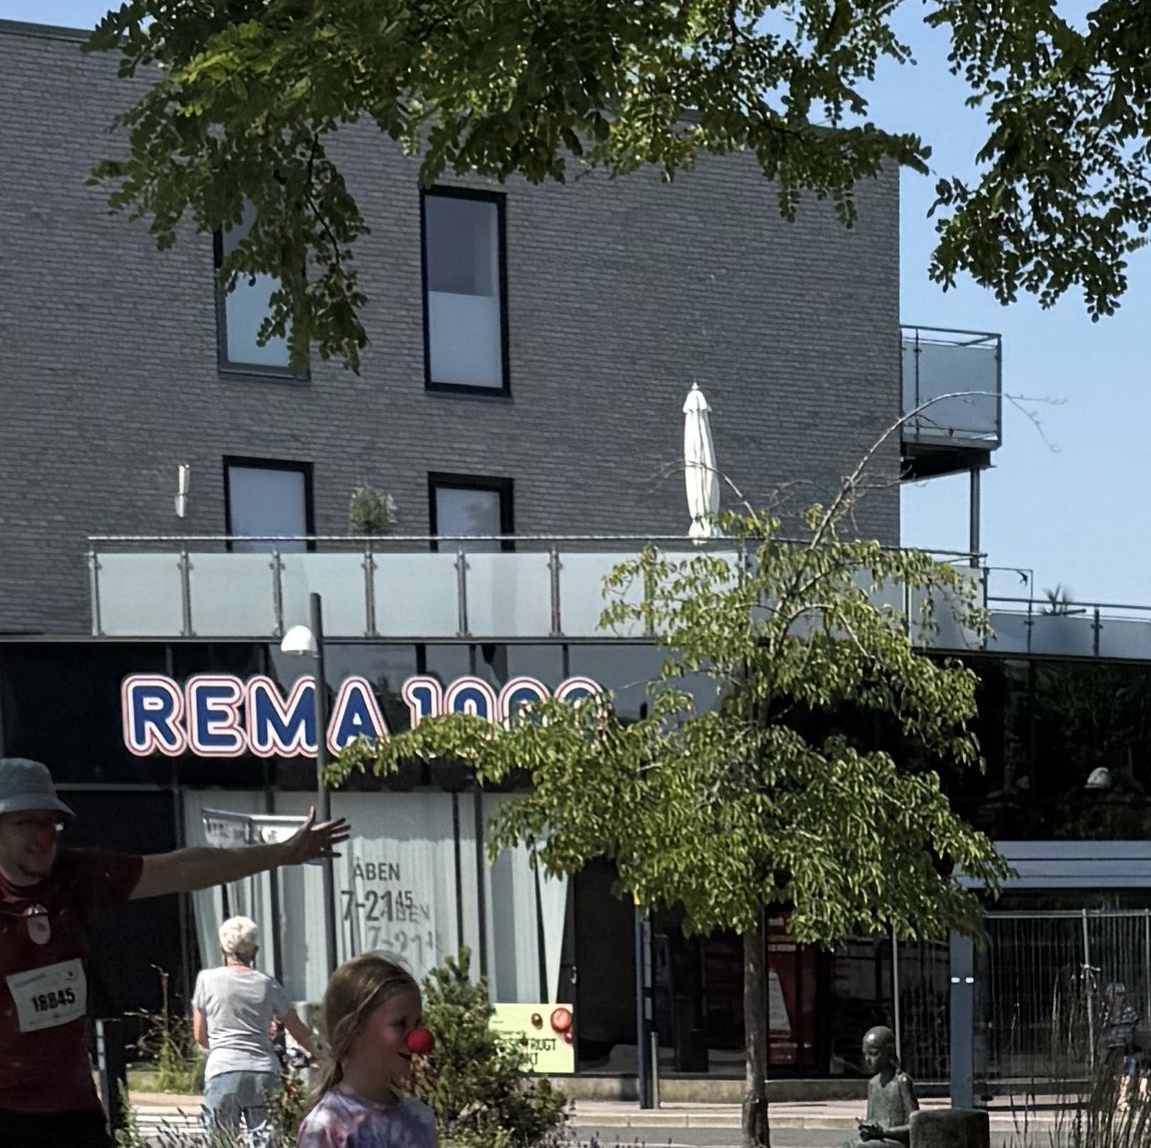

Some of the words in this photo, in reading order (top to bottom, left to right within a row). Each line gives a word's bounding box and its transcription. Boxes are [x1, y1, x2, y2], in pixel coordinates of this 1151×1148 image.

[122, 674, 390, 758] REMA
[353, 857, 400, 881] ÅBEN
[32, 987, 75, 1012] 18845
